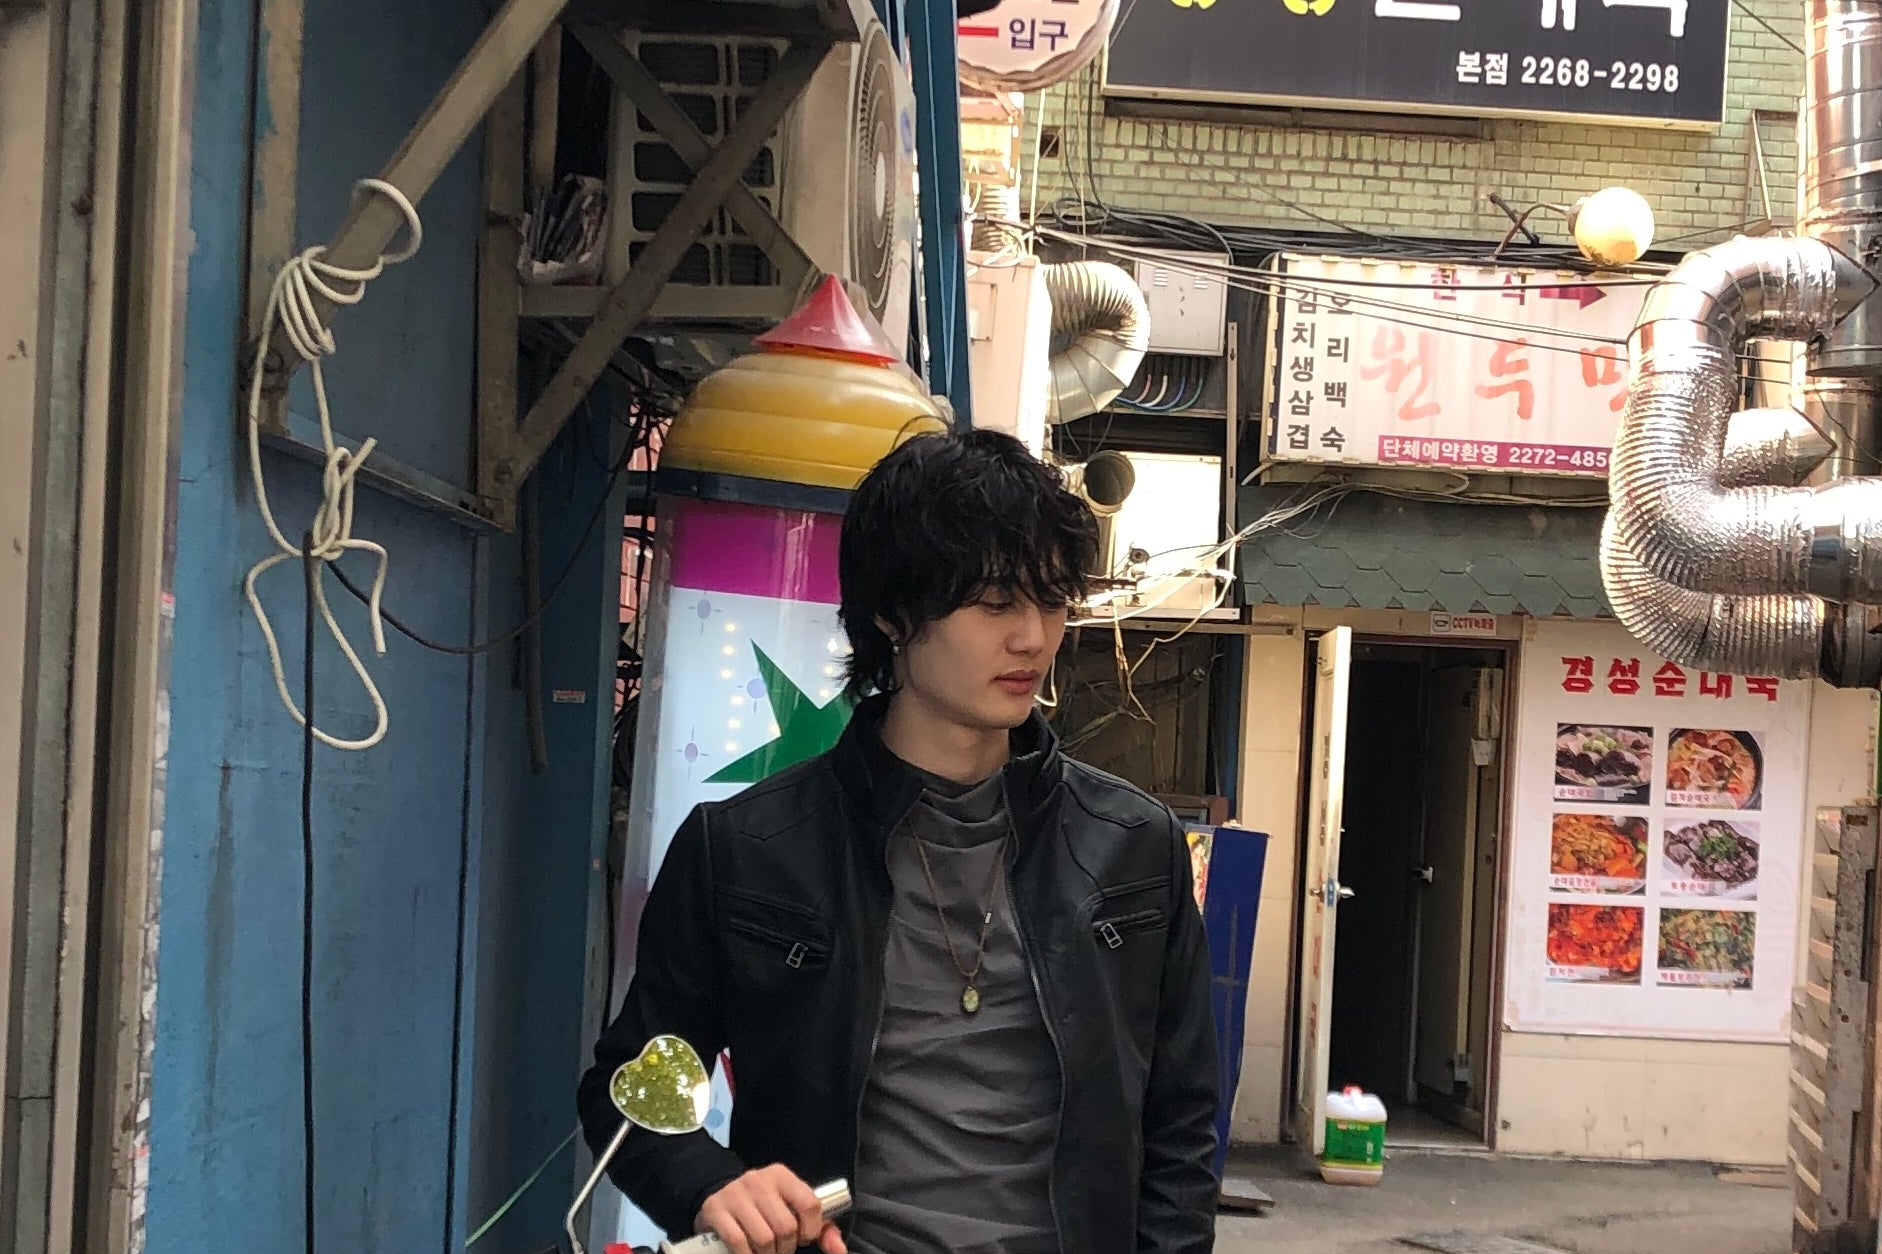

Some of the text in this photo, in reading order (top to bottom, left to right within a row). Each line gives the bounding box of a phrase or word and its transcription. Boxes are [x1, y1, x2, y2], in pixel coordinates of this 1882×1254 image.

[1008, 17, 1069, 52] 입구
[1455, 50, 1680, 93] 본점 2268-2298
[1508, 446, 1612, 469] 2272-485
